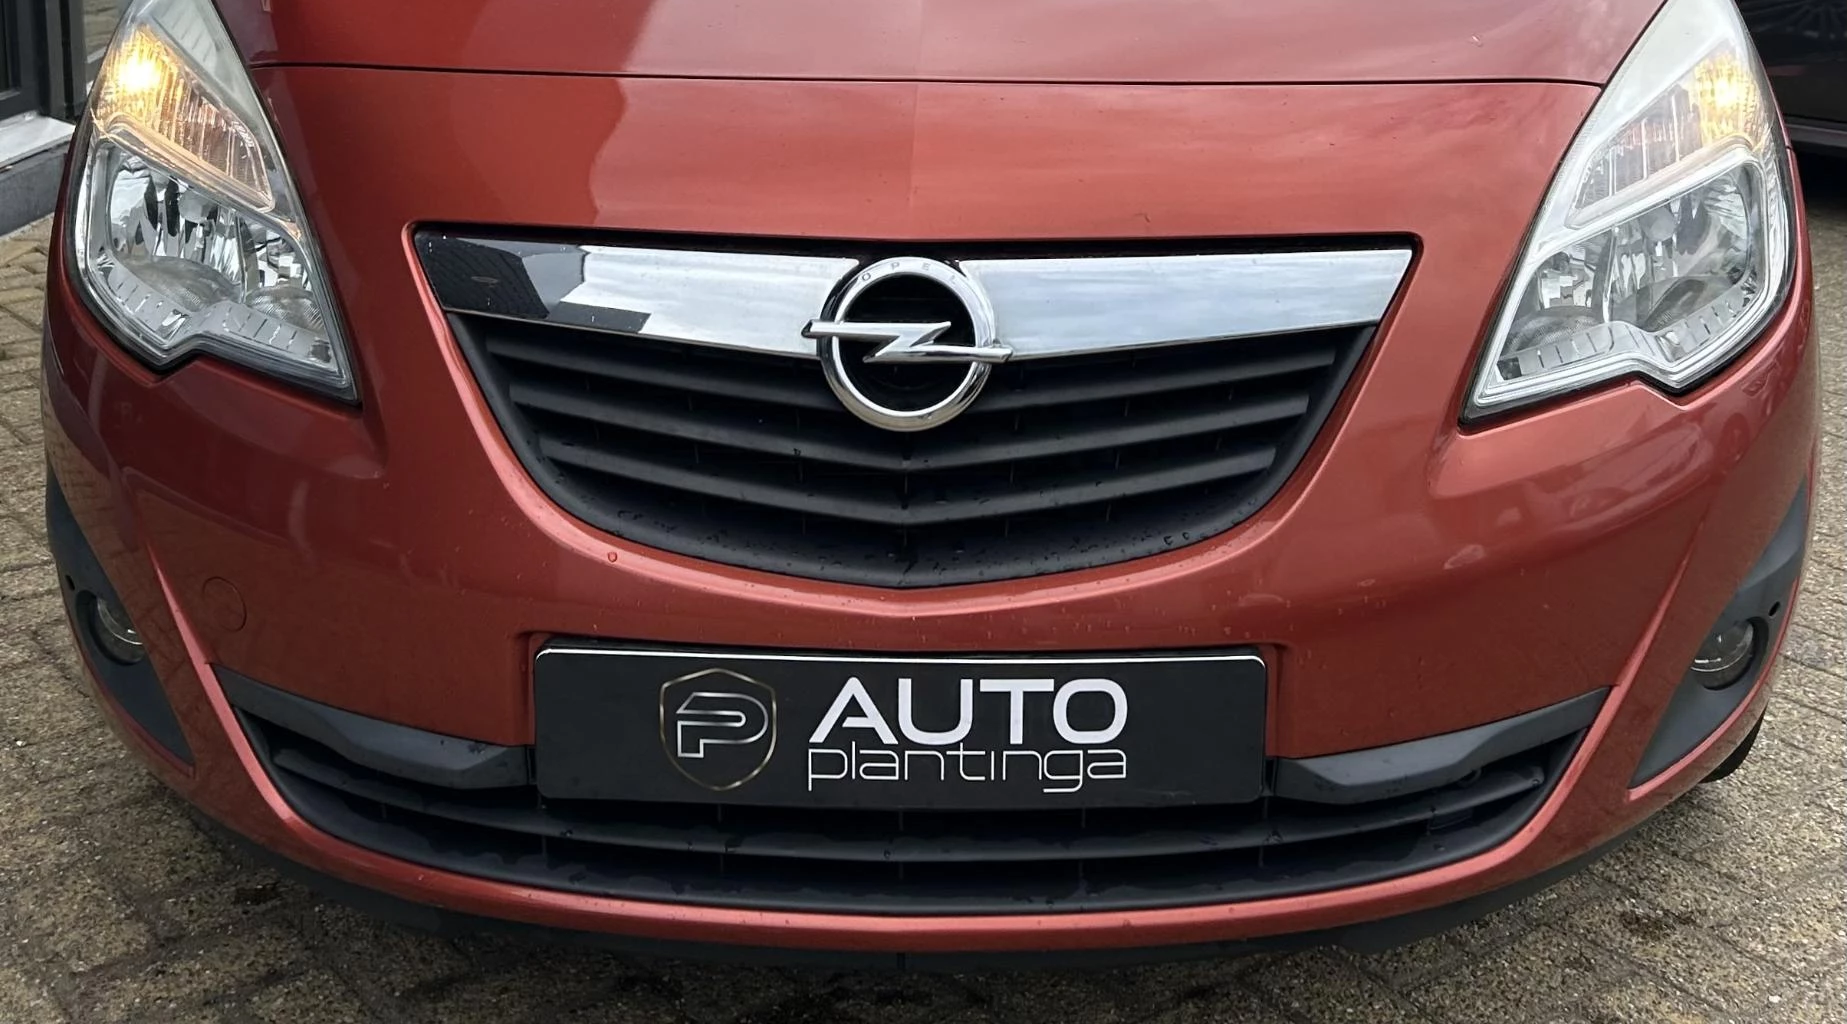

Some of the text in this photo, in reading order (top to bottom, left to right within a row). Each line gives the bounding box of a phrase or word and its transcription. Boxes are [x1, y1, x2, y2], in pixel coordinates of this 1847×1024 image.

[861, 261, 959, 285] OPEL
[808, 677, 1128, 745] AUTO
[807, 741, 1128, 793] plantinga
